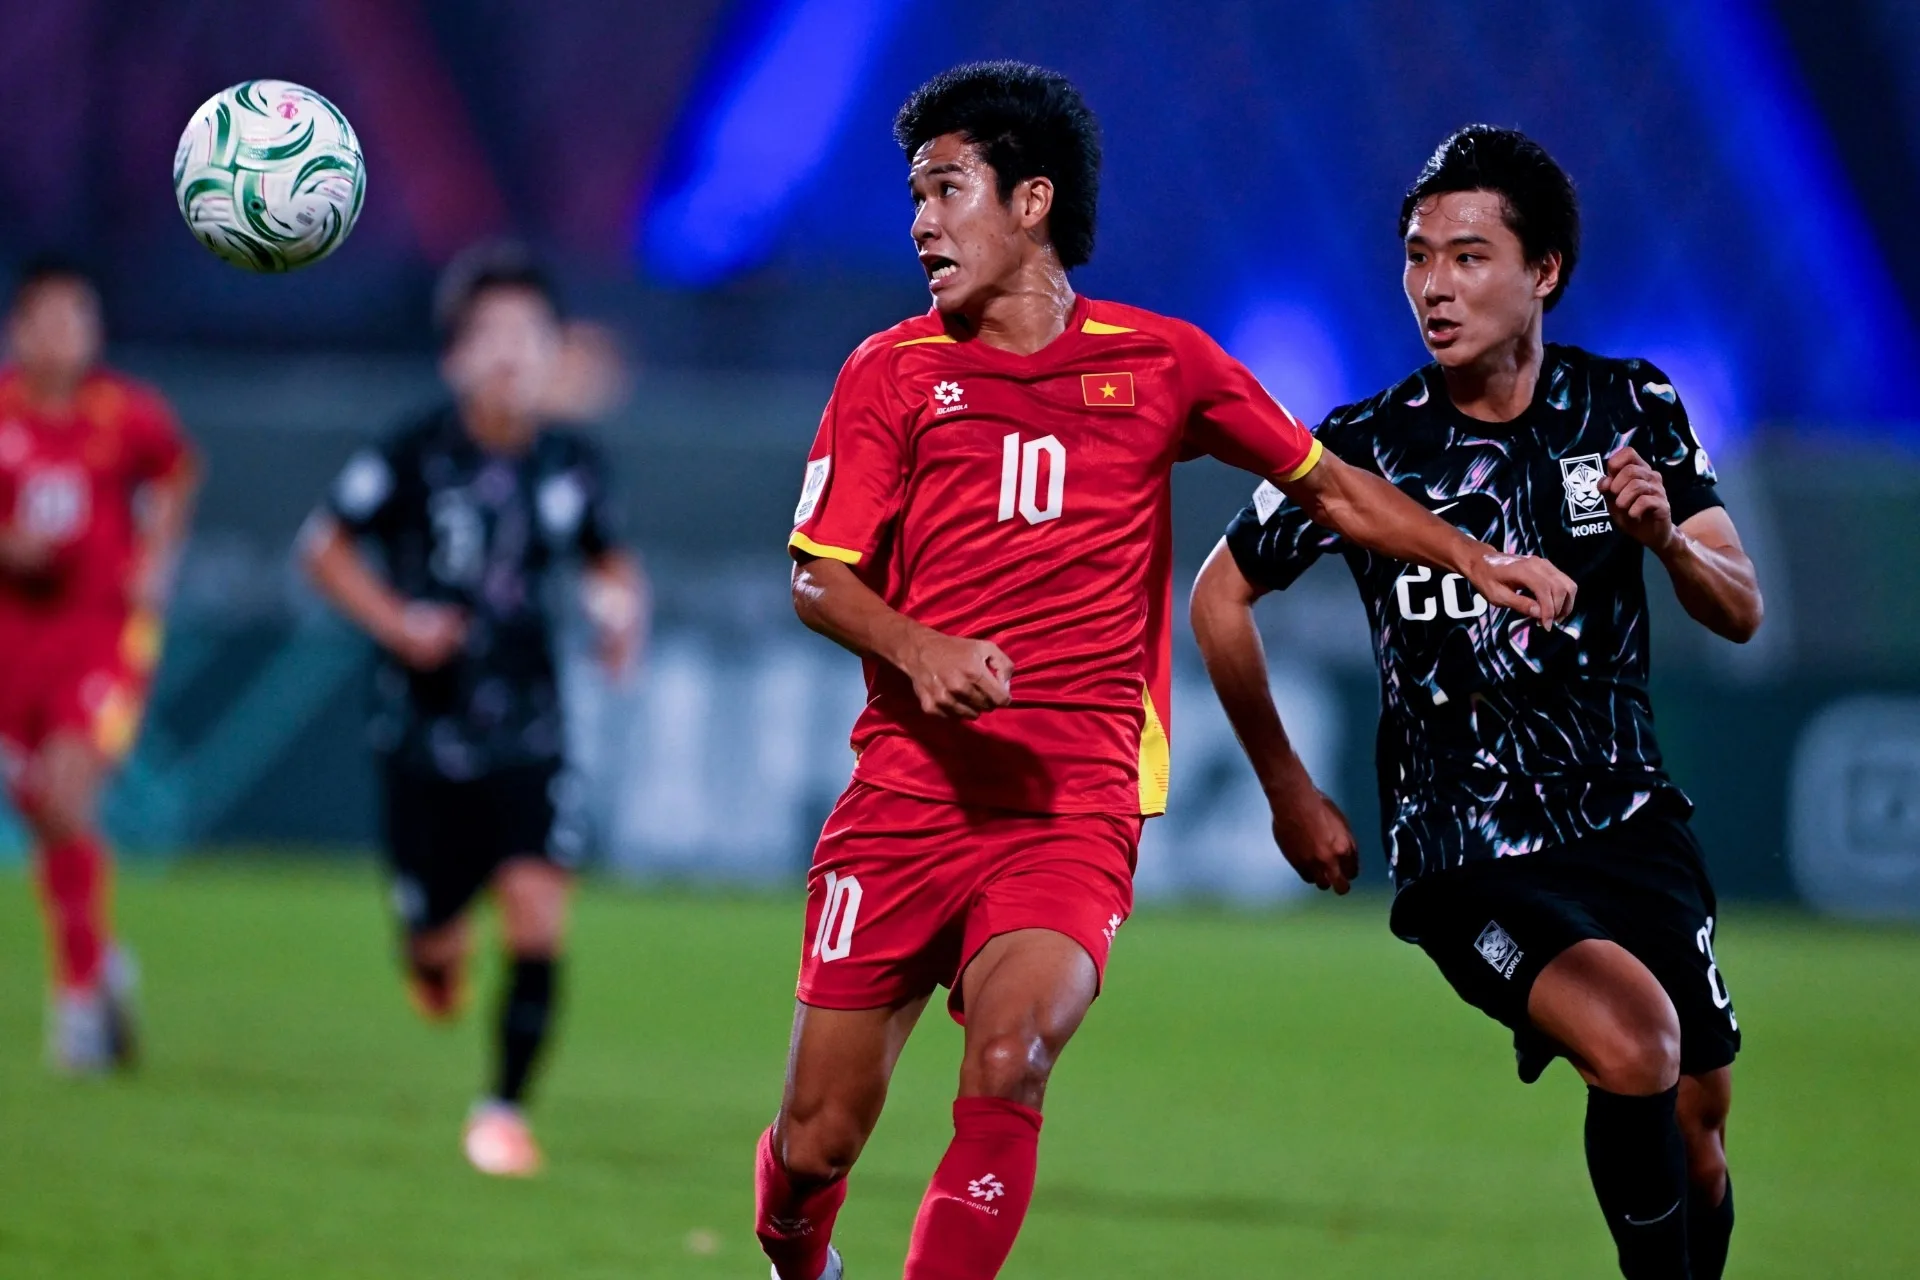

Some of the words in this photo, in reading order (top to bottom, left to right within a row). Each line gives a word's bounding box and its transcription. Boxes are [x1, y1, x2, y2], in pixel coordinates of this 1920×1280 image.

[998, 432, 1066, 526] 10
[1571, 521, 1613, 538] KOREA
[811, 870, 863, 963] 10
[1503, 950, 1525, 981] KOREA
